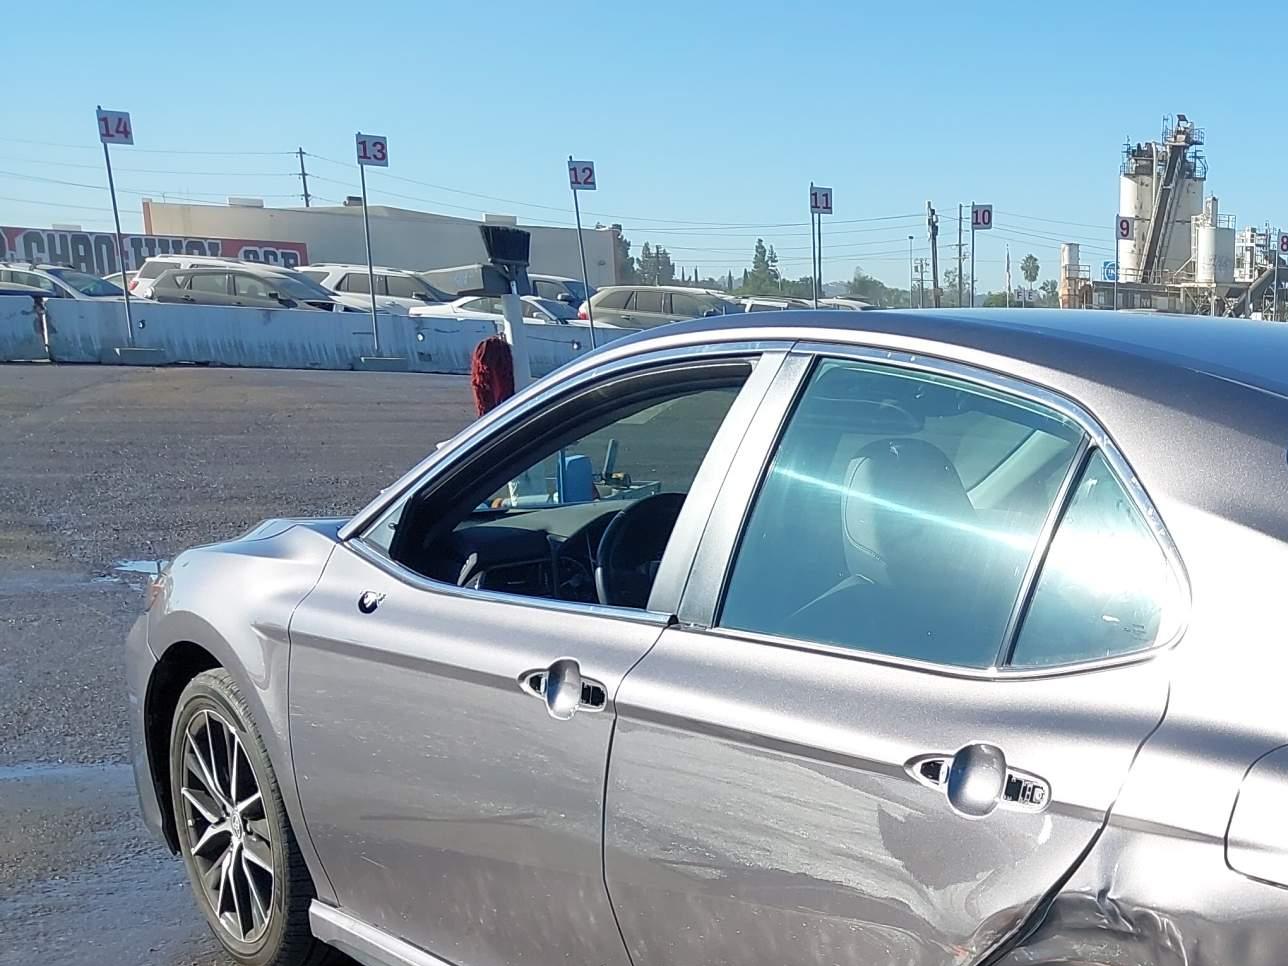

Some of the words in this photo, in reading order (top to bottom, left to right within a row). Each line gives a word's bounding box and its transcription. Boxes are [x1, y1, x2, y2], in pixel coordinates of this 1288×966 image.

[100, 117, 130, 139] 14
[358, 140, 387, 161] 13
[570, 167, 595, 185] 12
[811, 192, 832, 210] 11
[973, 210, 991, 225] 10
[1119, 220, 1130, 237] 9
[1280, 235, 1288, 252] 8
